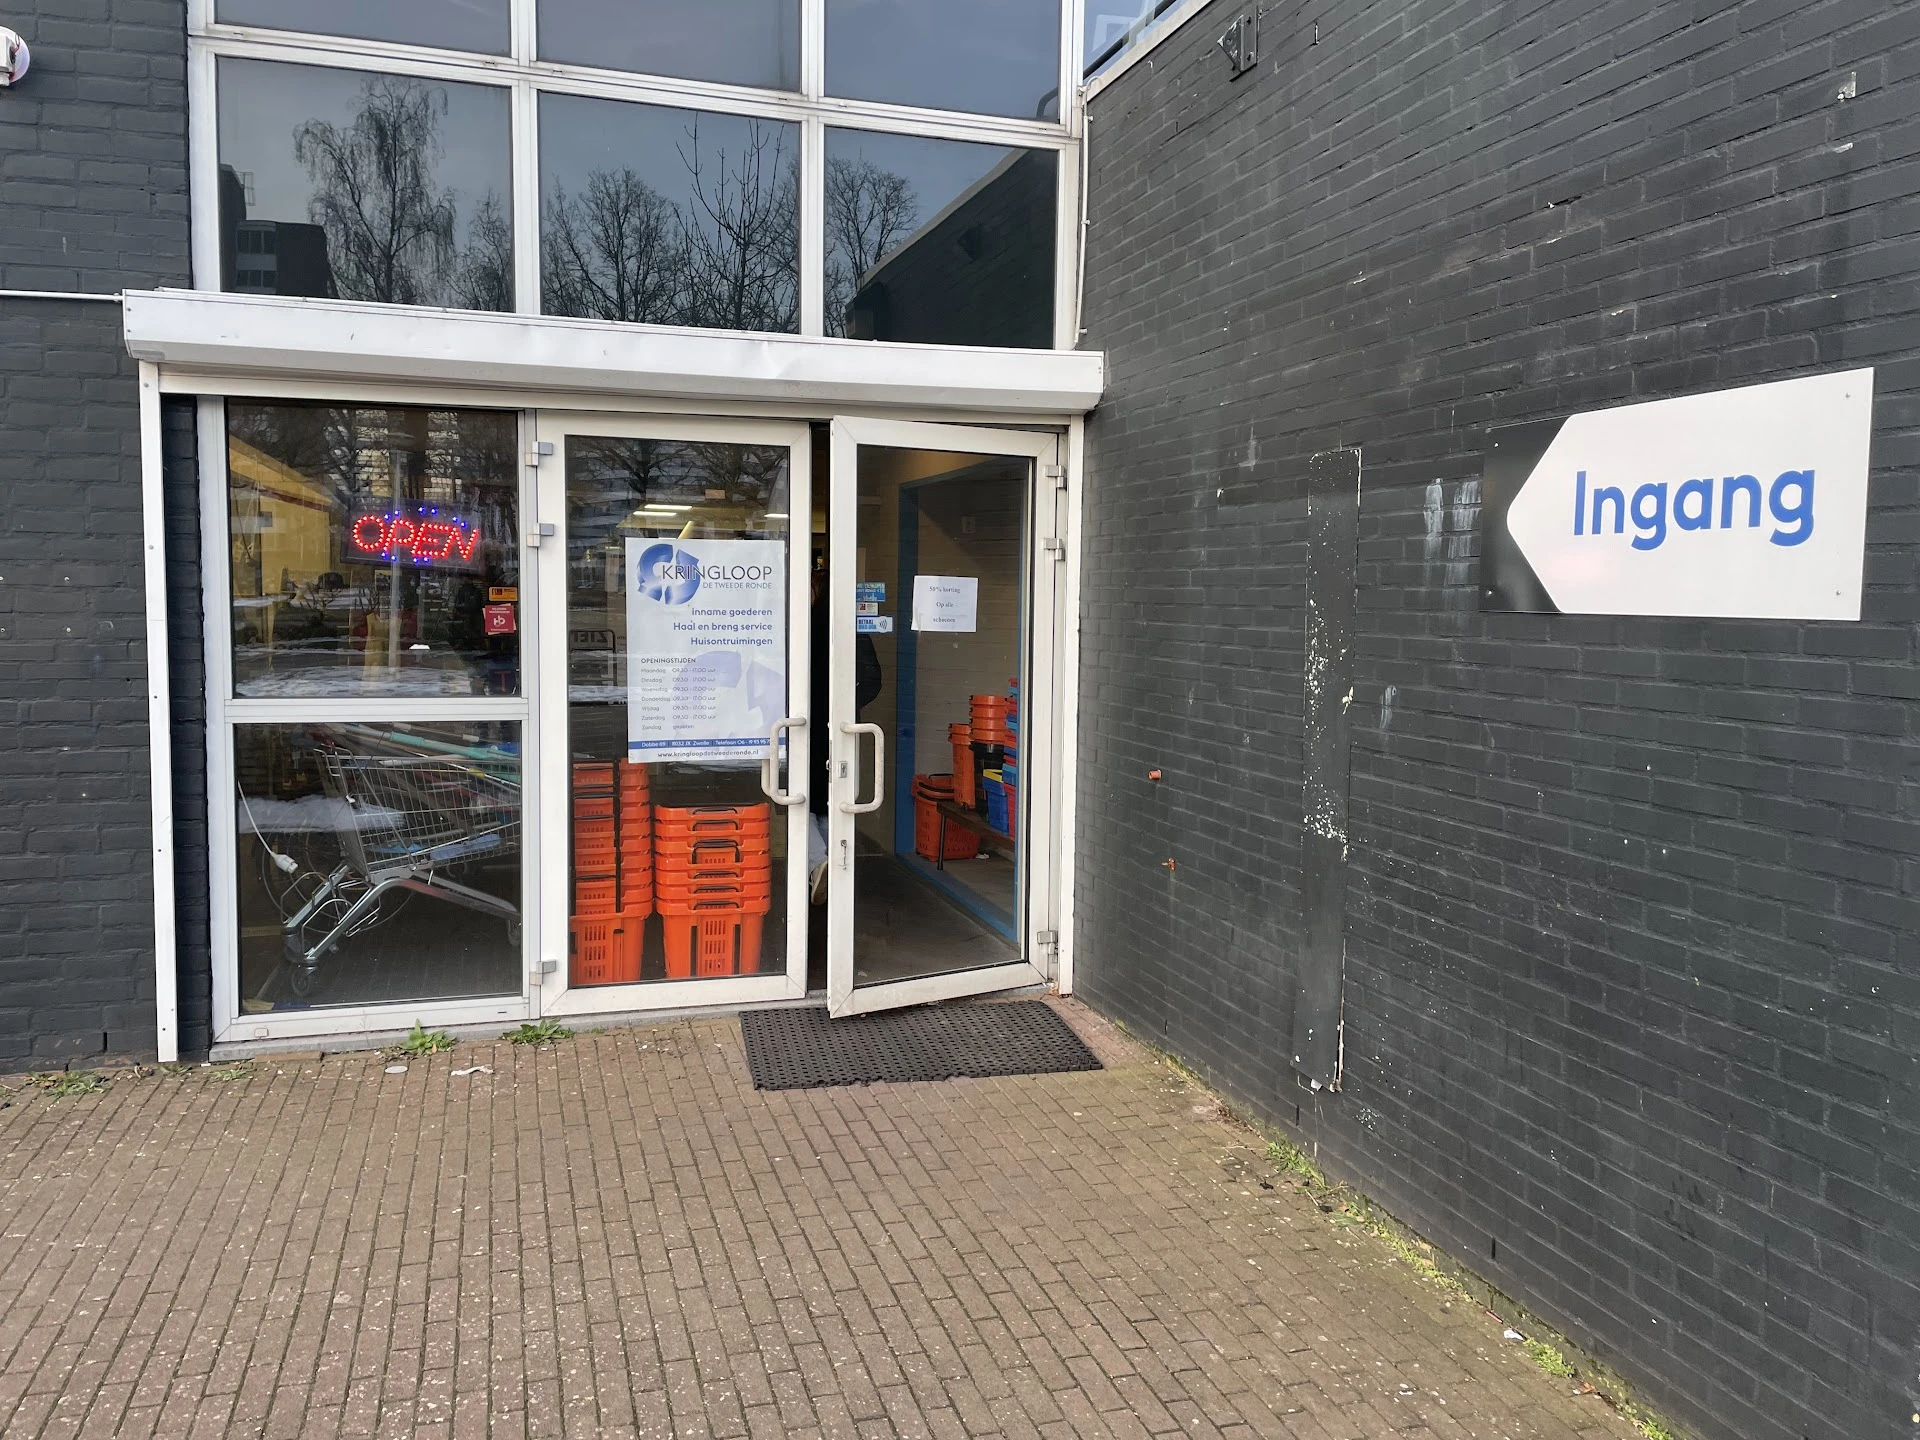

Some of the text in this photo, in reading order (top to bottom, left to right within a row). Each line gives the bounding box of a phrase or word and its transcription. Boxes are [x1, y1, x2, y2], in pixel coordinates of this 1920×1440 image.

[1574, 469, 1815, 551] Ingang
[352, 514, 480, 561] OPEN
[662, 565, 772, 581] KRINGLOOP
[729, 607, 772, 618] goederen
[673, 622, 695, 631] Haal
[712, 622, 739, 632] breng
[741, 623, 773, 631] service
[690, 637, 773, 647] Huisontruimingen
